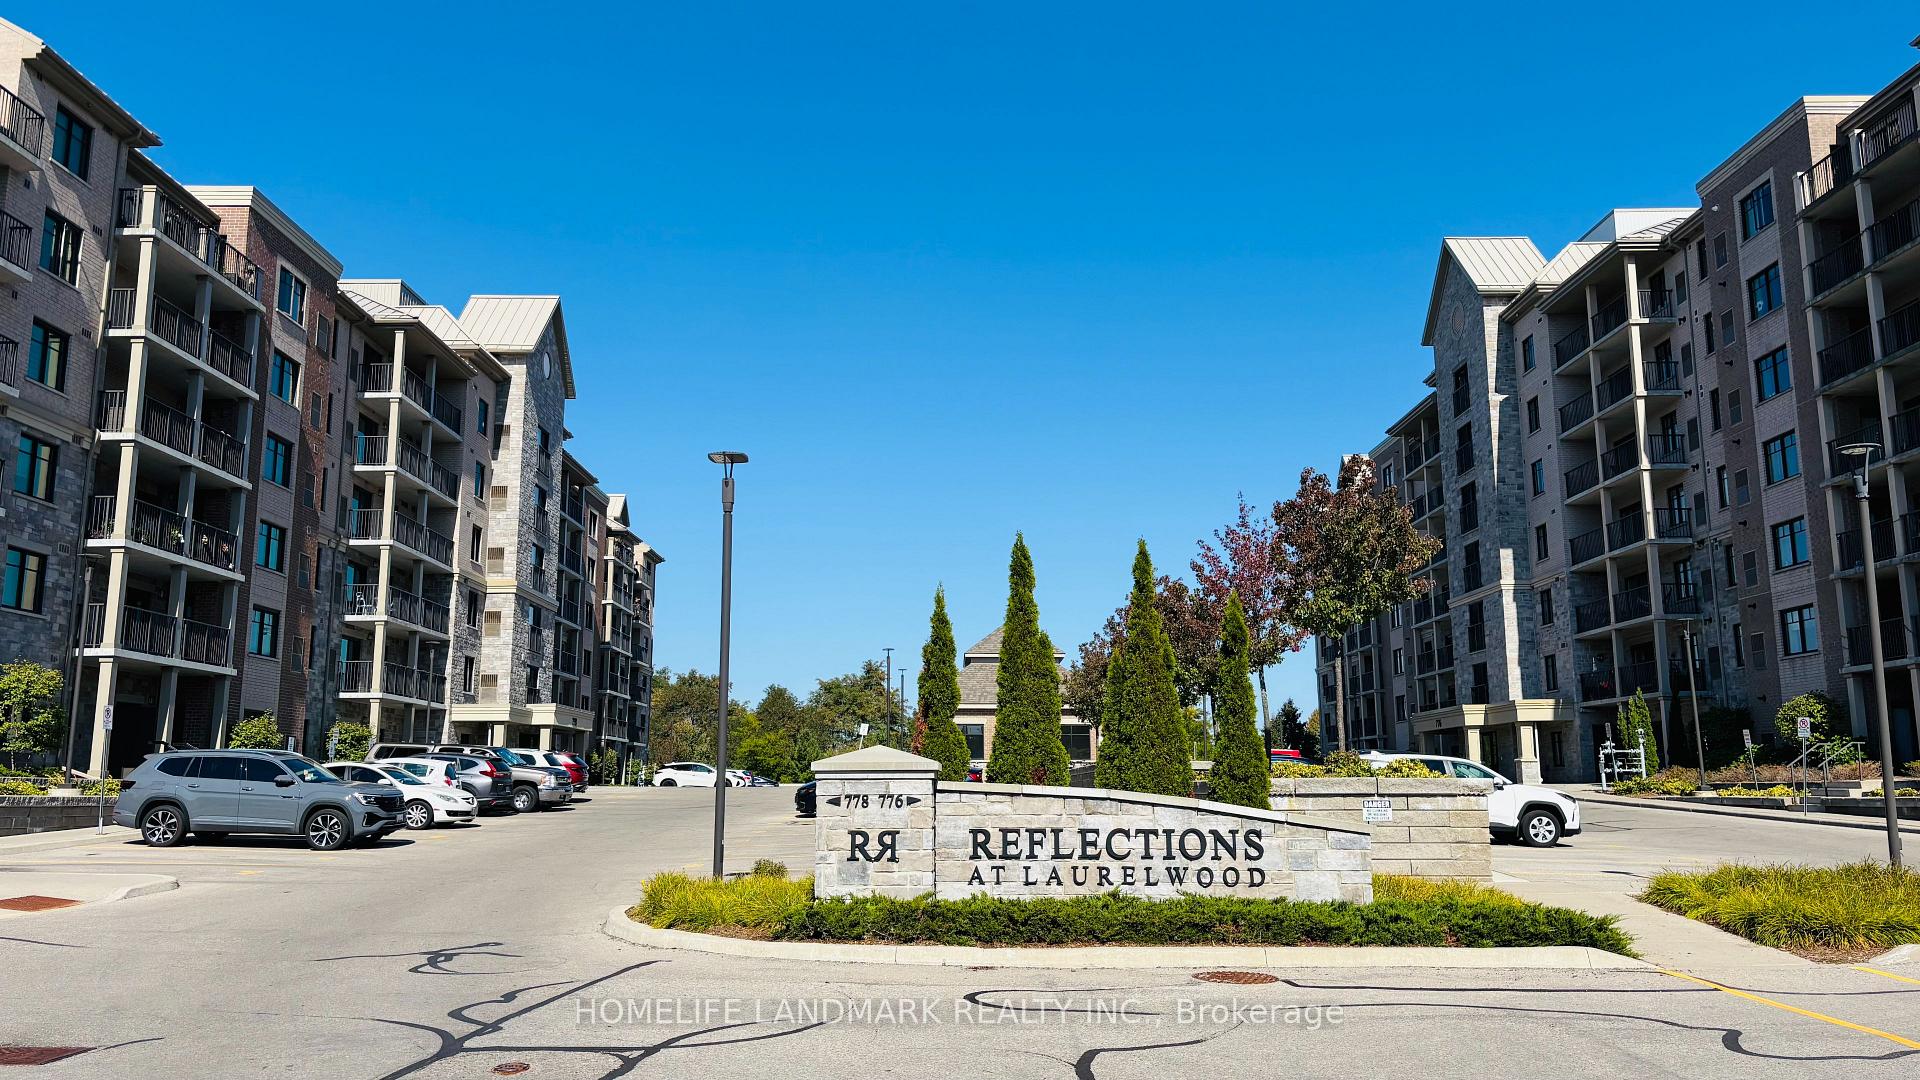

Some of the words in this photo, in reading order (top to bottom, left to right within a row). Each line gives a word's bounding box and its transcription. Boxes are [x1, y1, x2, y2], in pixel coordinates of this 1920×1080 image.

[844, 794, 869, 809] 778
[878, 794, 904, 809] 776
[968, 827, 1265, 861] REFLECTIONS
[967, 865, 1006, 886] AT
[1023, 865, 1266, 888] LAURELWOOD
